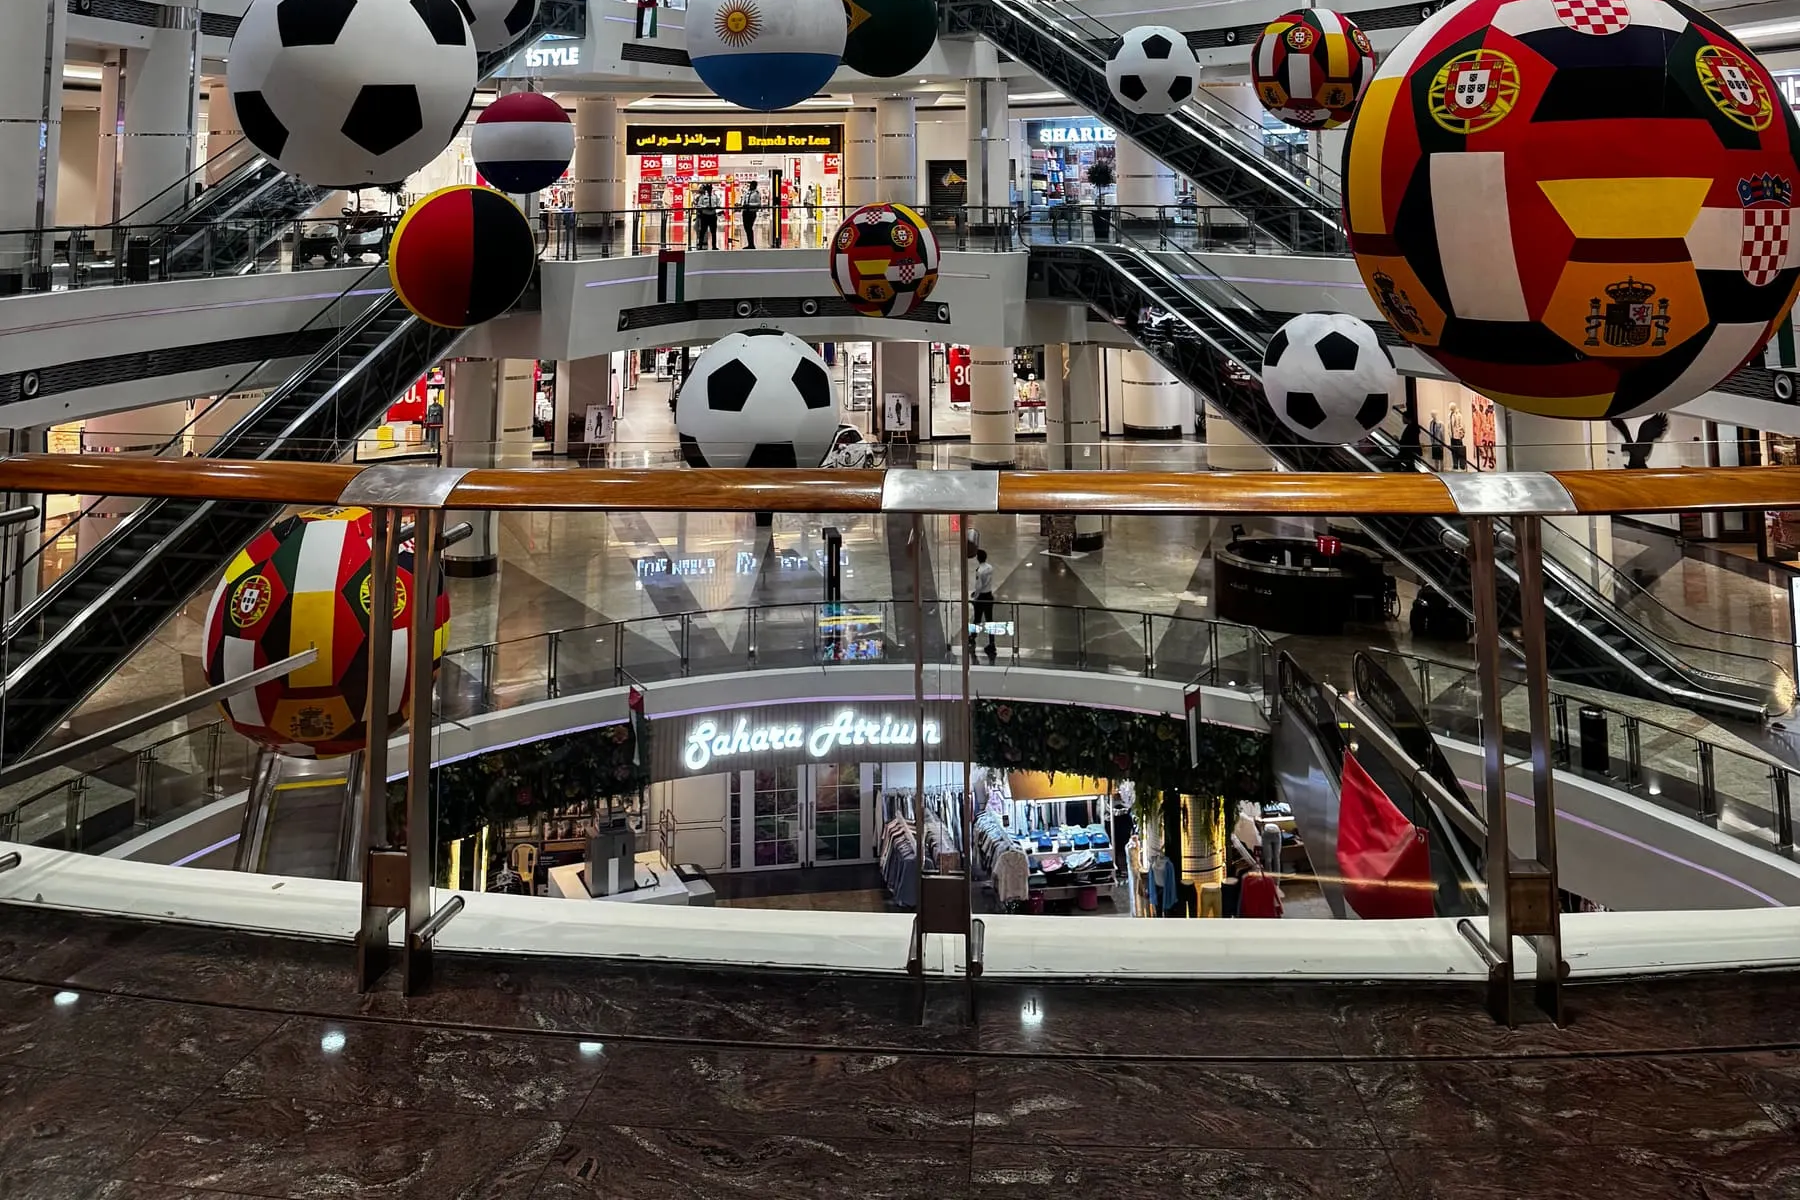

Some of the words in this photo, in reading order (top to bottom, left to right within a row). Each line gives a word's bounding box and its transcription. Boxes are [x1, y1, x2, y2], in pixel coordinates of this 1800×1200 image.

[525, 47, 579, 67] iSTYLE
[636, 133, 656, 147] لس
[656, 133, 682, 147] فور
[682, 133, 721, 146] براندز
[748, 135, 787, 146] Brands
[787, 135, 807, 146] For
[808, 135, 831, 146] Less
[684, 718, 804, 770] Sahara
